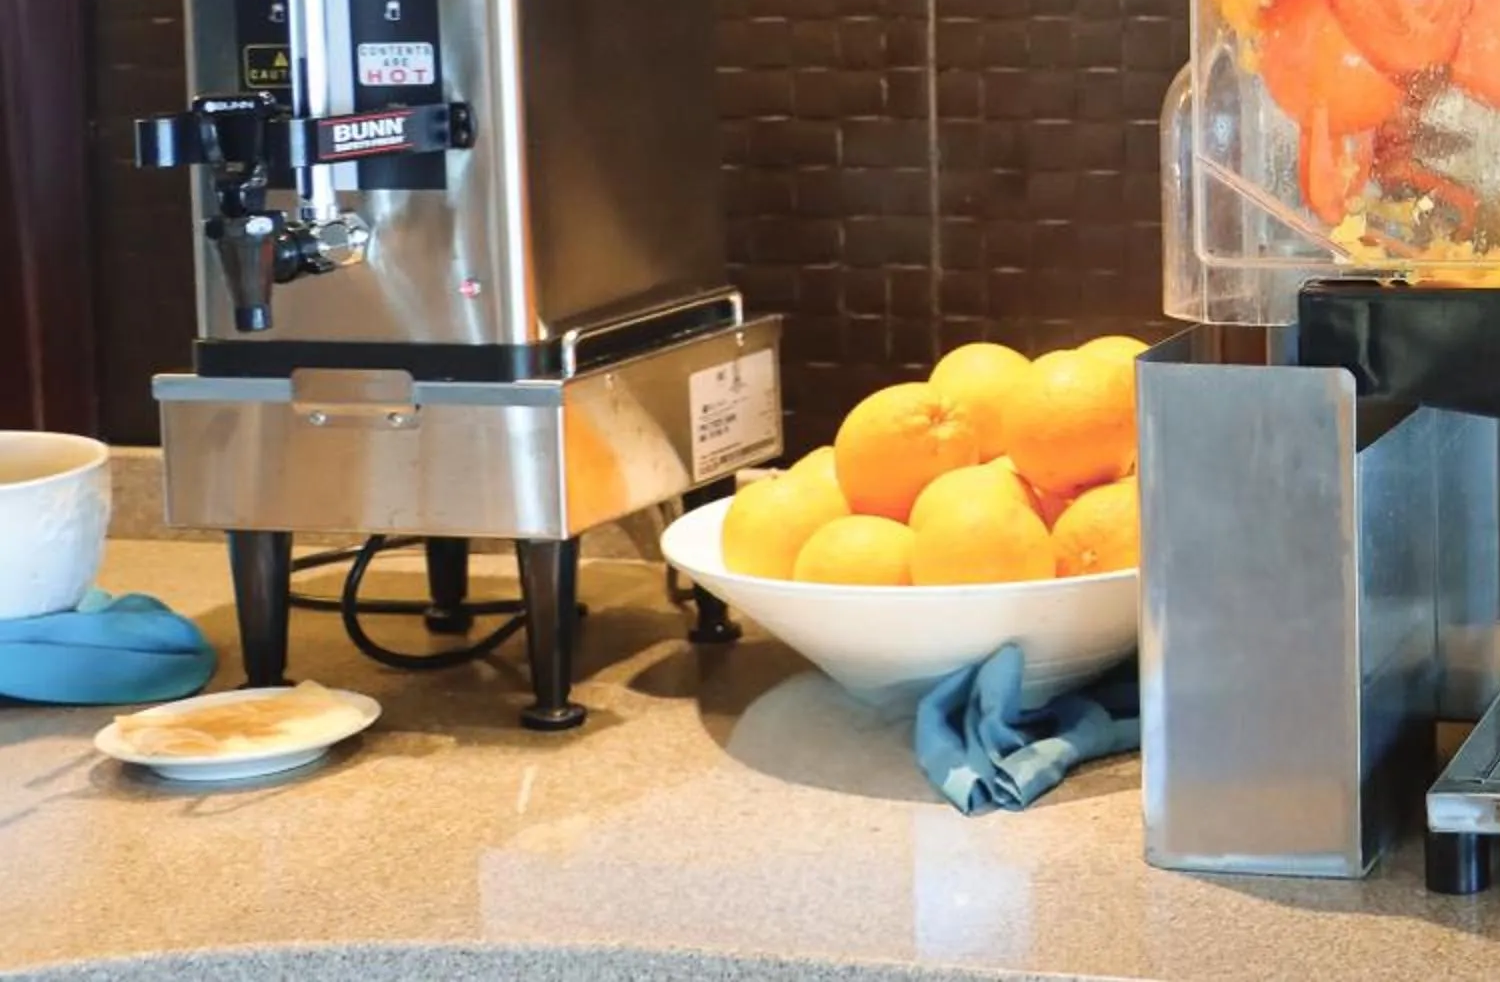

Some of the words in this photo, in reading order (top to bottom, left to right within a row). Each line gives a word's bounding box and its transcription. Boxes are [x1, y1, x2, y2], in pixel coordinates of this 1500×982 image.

[358, 44, 432, 57] CONTENTS
[383, 57, 409, 68] ARE
[249, 68, 289, 80] CAUT
[366, 69, 428, 84] HOT
[333, 117, 404, 143] BUNN
